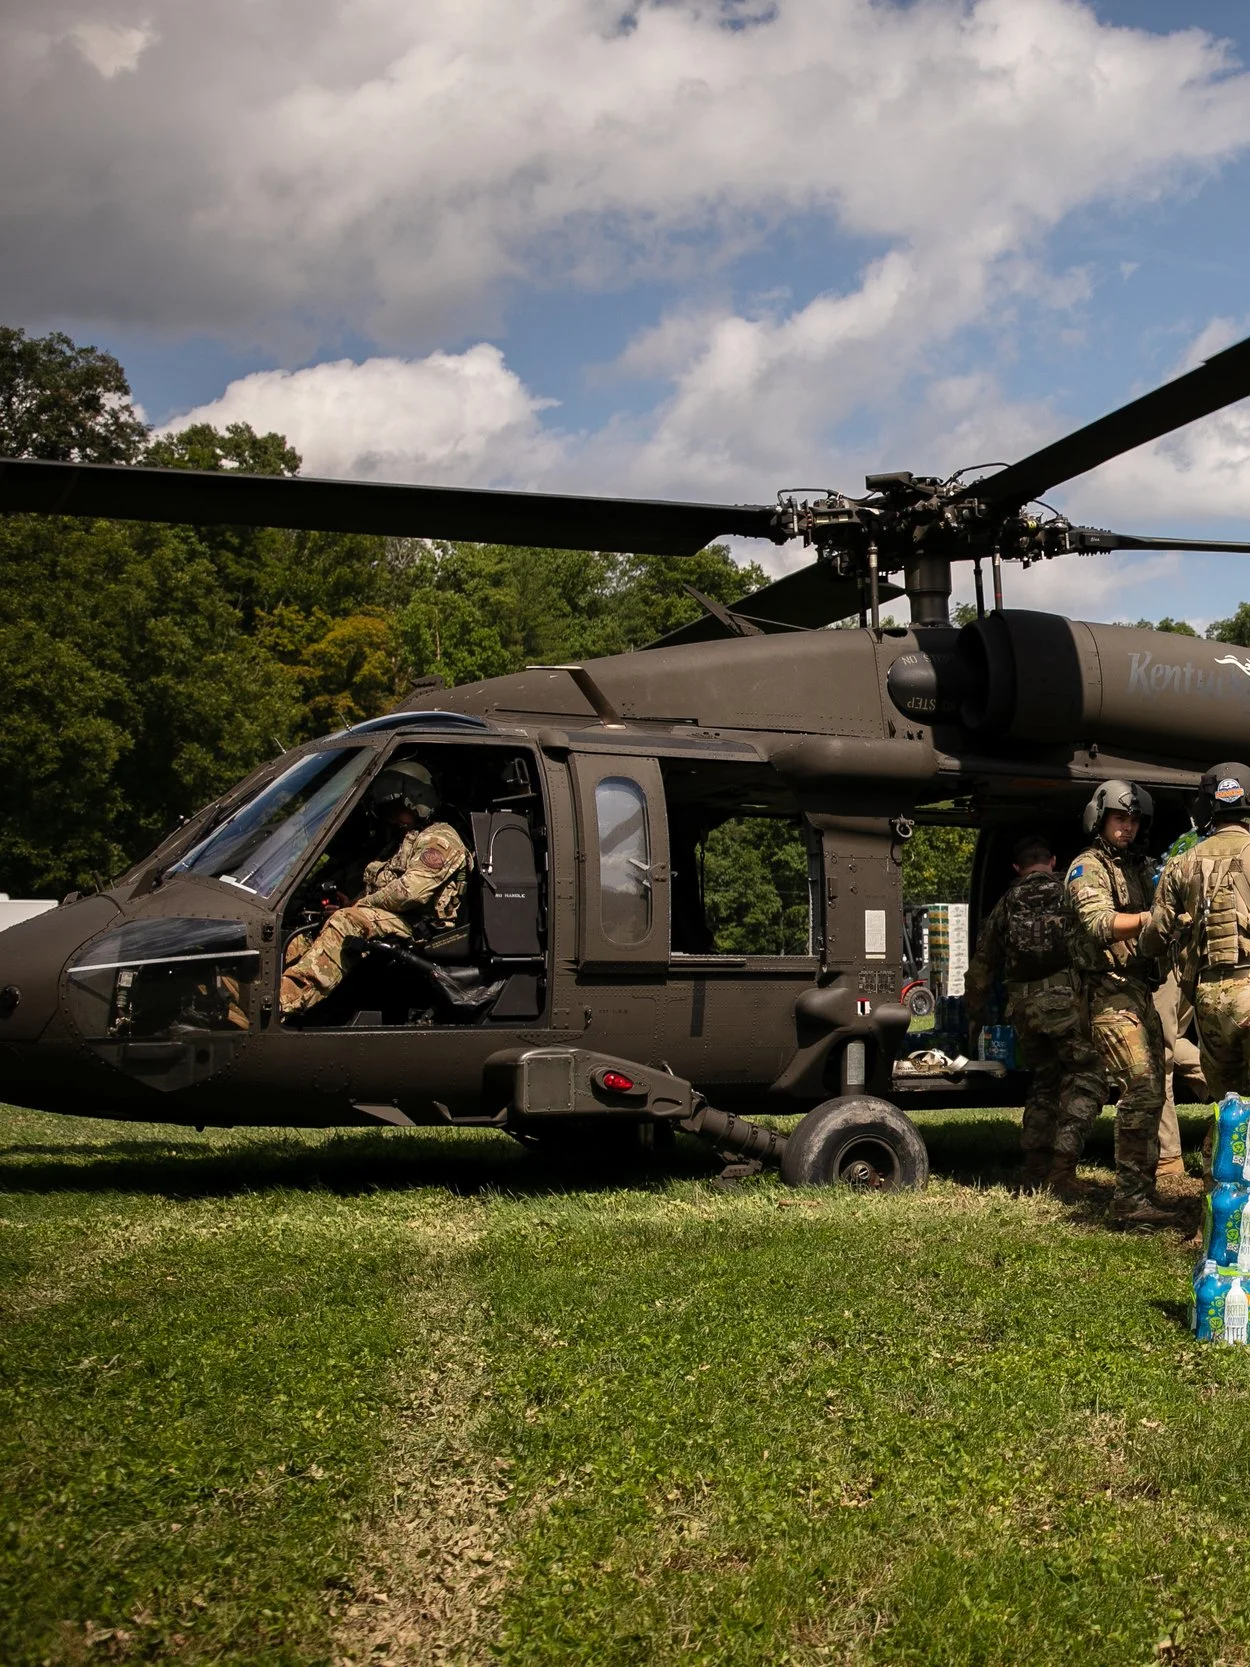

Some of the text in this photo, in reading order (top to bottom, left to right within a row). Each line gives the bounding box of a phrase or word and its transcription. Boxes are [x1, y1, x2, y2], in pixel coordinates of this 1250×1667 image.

[902, 655, 917, 664] NO
[1242, 1235, 1247, 1245] A
[1226, 1304, 1245, 1317] BOTTLE
